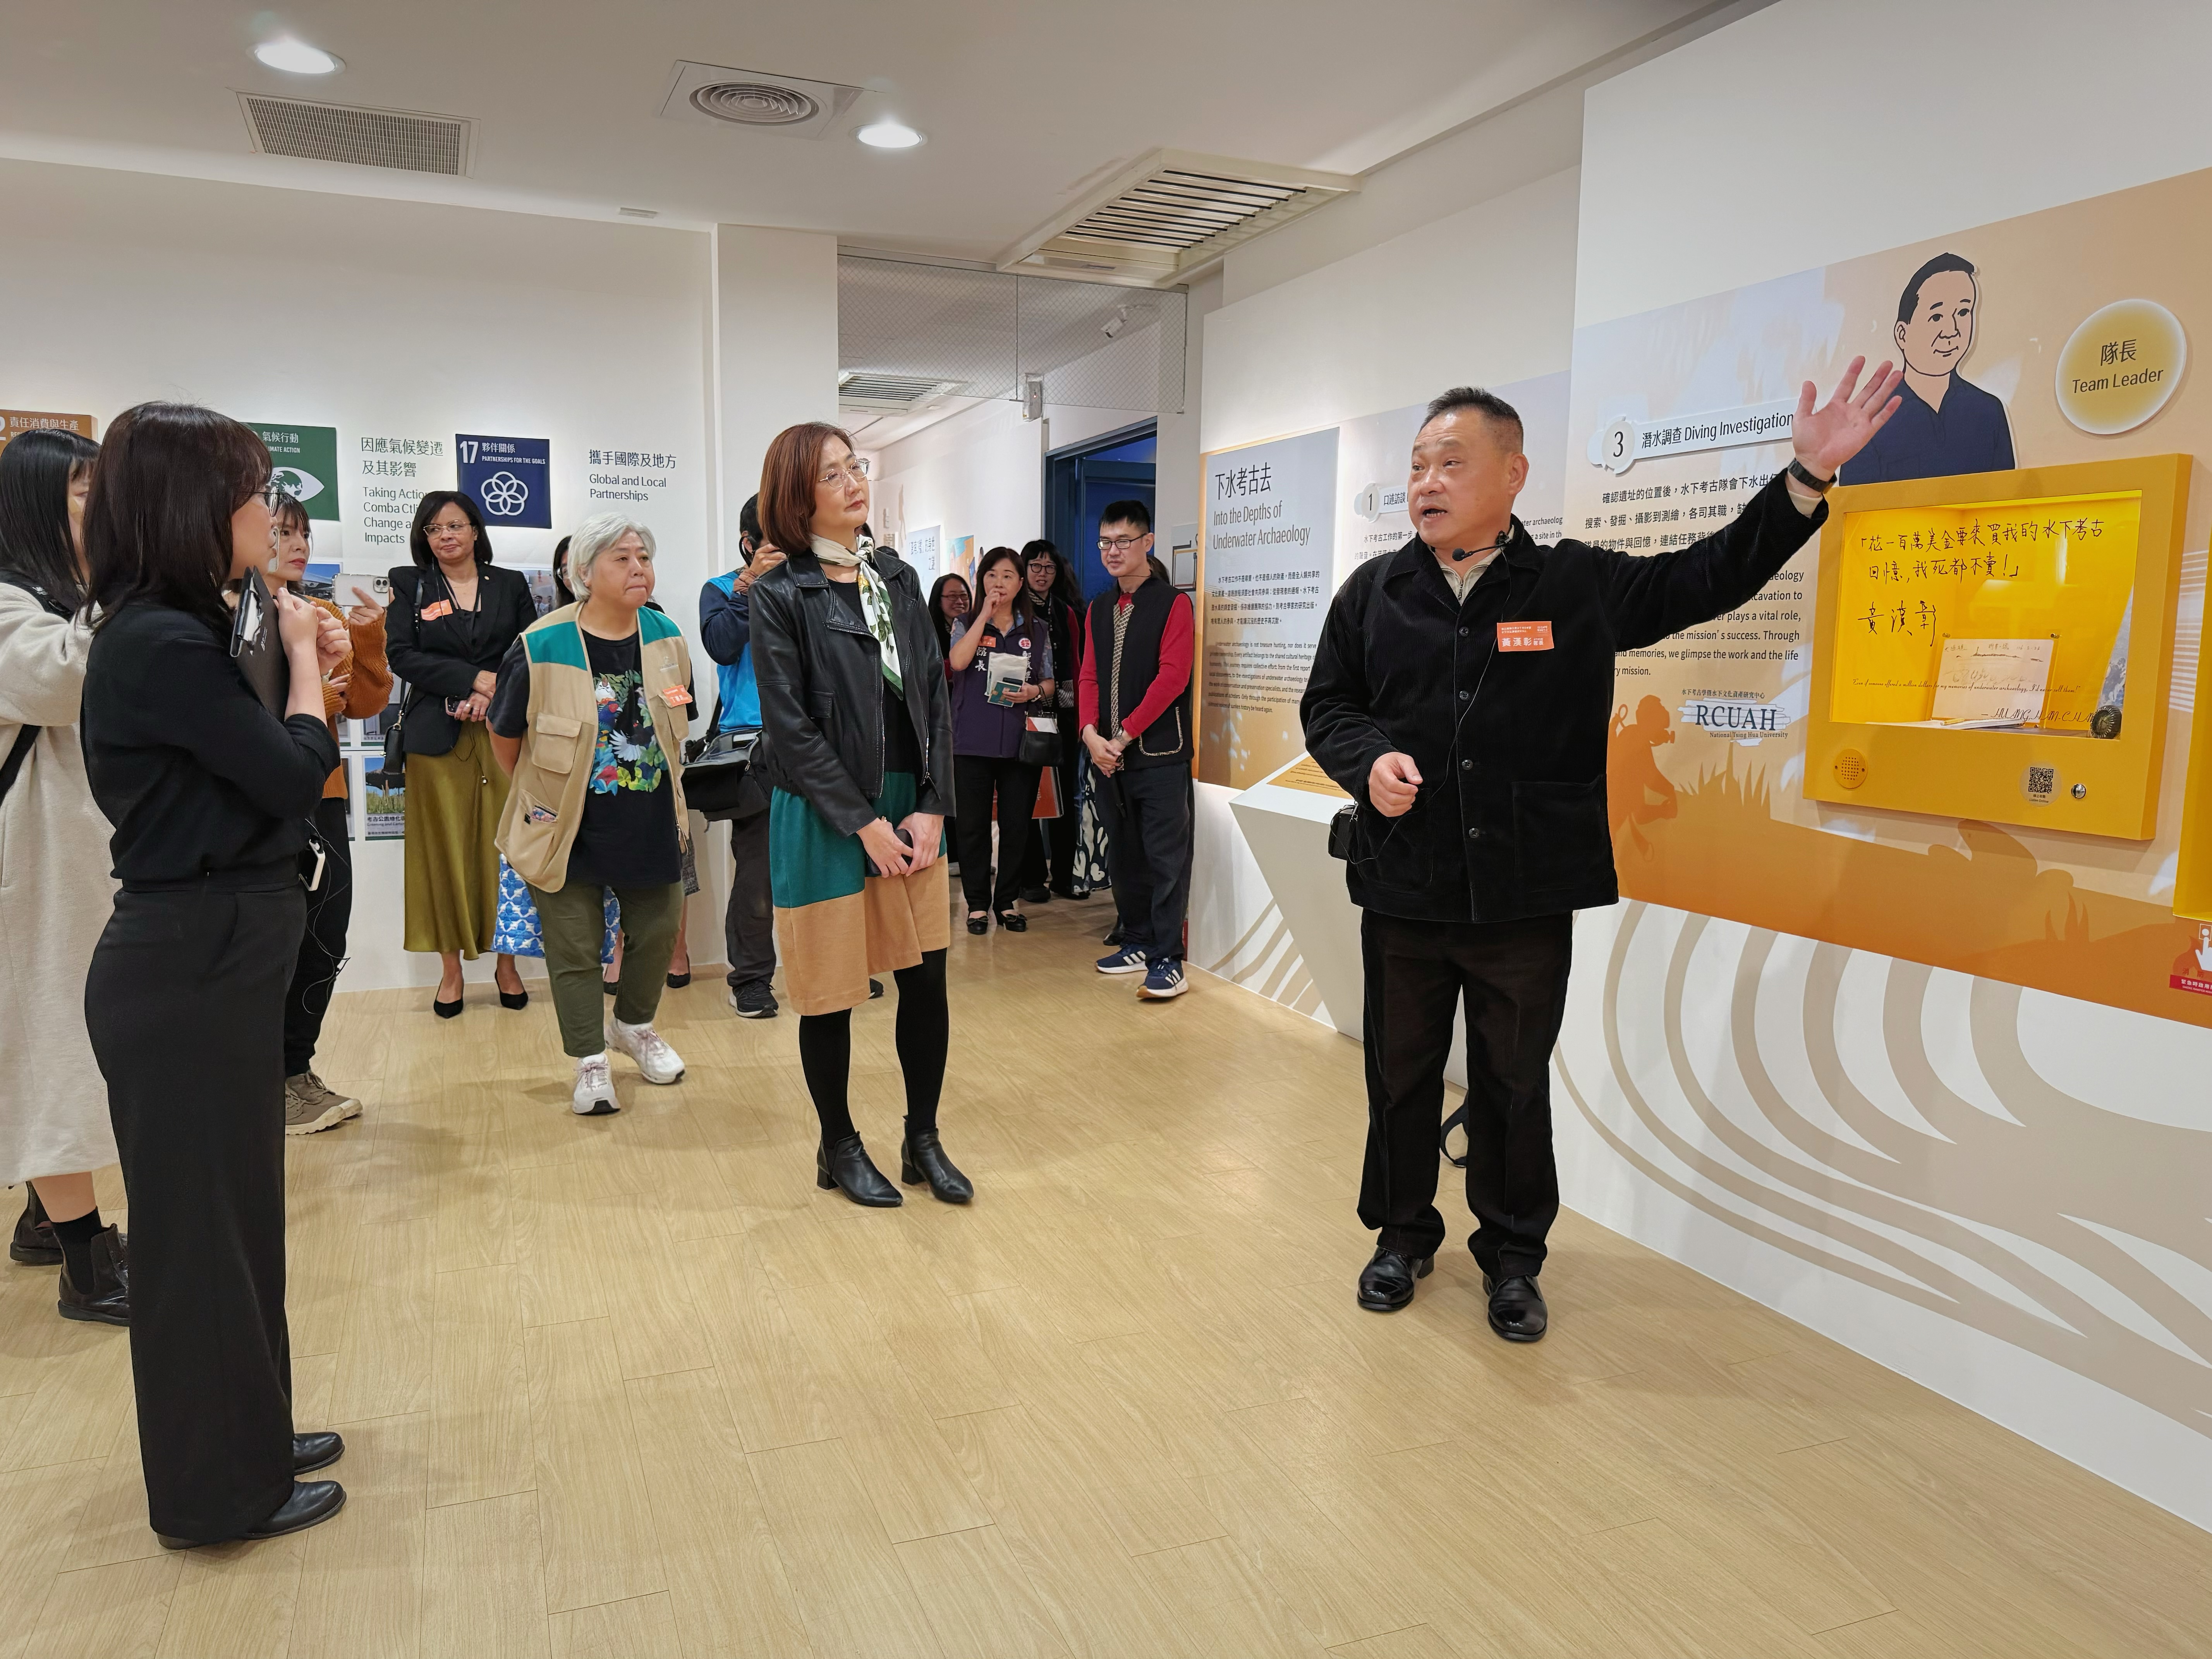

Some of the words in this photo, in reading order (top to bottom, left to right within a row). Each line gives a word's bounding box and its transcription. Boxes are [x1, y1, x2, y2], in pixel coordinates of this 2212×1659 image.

[2100, 339, 2137, 366] 隊長
[2073, 378, 2108, 393] Team
[2113, 368, 2164, 388] Leader
[10, 416, 79, 431] 責任消費與生產
[263, 431, 299, 443] 氣候行動
[1613, 431, 1624, 457] 3
[1642, 426, 1682, 449] 潛水調查
[1685, 425, 1716, 441] Diving
[1719, 412, 1794, 435] Investigation
[361, 437, 443, 456] 因應氣候變遷
[460, 441, 479, 464] 17
[482, 442, 515, 453] 夥伴關係
[589, 449, 677, 469] 攜手國際及地方
[362, 460, 417, 477] 及其影響
[589, 474, 619, 484] Global
[622, 476, 639, 486] and
[642, 477, 666, 487] Local
[1215, 462, 1271, 500] 下水考古去
[362, 487, 396, 501] Taking
[591, 489, 648, 502] Partnerships
[1369, 493, 1372, 511] 1
[1384, 492, 1405, 505] 口述訪談
[364, 502, 400, 513] Comba
[1214, 511, 1228, 526] Into
[1230, 507, 1242, 524] the
[1243, 503, 1271, 526] Depths
[1273, 500, 1282, 518] of
[364, 517, 403, 531] Change
[1533, 517, 1563, 525] archaeolog
[365, 532, 405, 545] Impacts
[1213, 532, 1256, 550] Underwater
[1257, 524, 1310, 546] Archaeology
[1794, 591, 1802, 600] to
[1728, 611, 1749, 623] plays
[1759, 610, 1778, 620] vital
[1781, 610, 1801, 622] role,
[1763, 630, 1799, 642] Through
[1629, 649, 1666, 659] memories,
[1681, 649, 1711, 660] glimpse
[1714, 649, 1726, 658] the
[1728, 650, 1748, 659] work
[1751, 650, 1766, 659] and
[1769, 650, 1783, 659] the
[1785, 650, 1798, 660] life
[1622, 666, 1650, 675] mission.
[1864, 678, 1869, 687] if
[1885, 679, 1898, 688] offered
[1968, 682, 1974, 690] of
[1999, 684, 2028, 693] archaeology,
[1695, 705, 1777, 731] RCUAH
